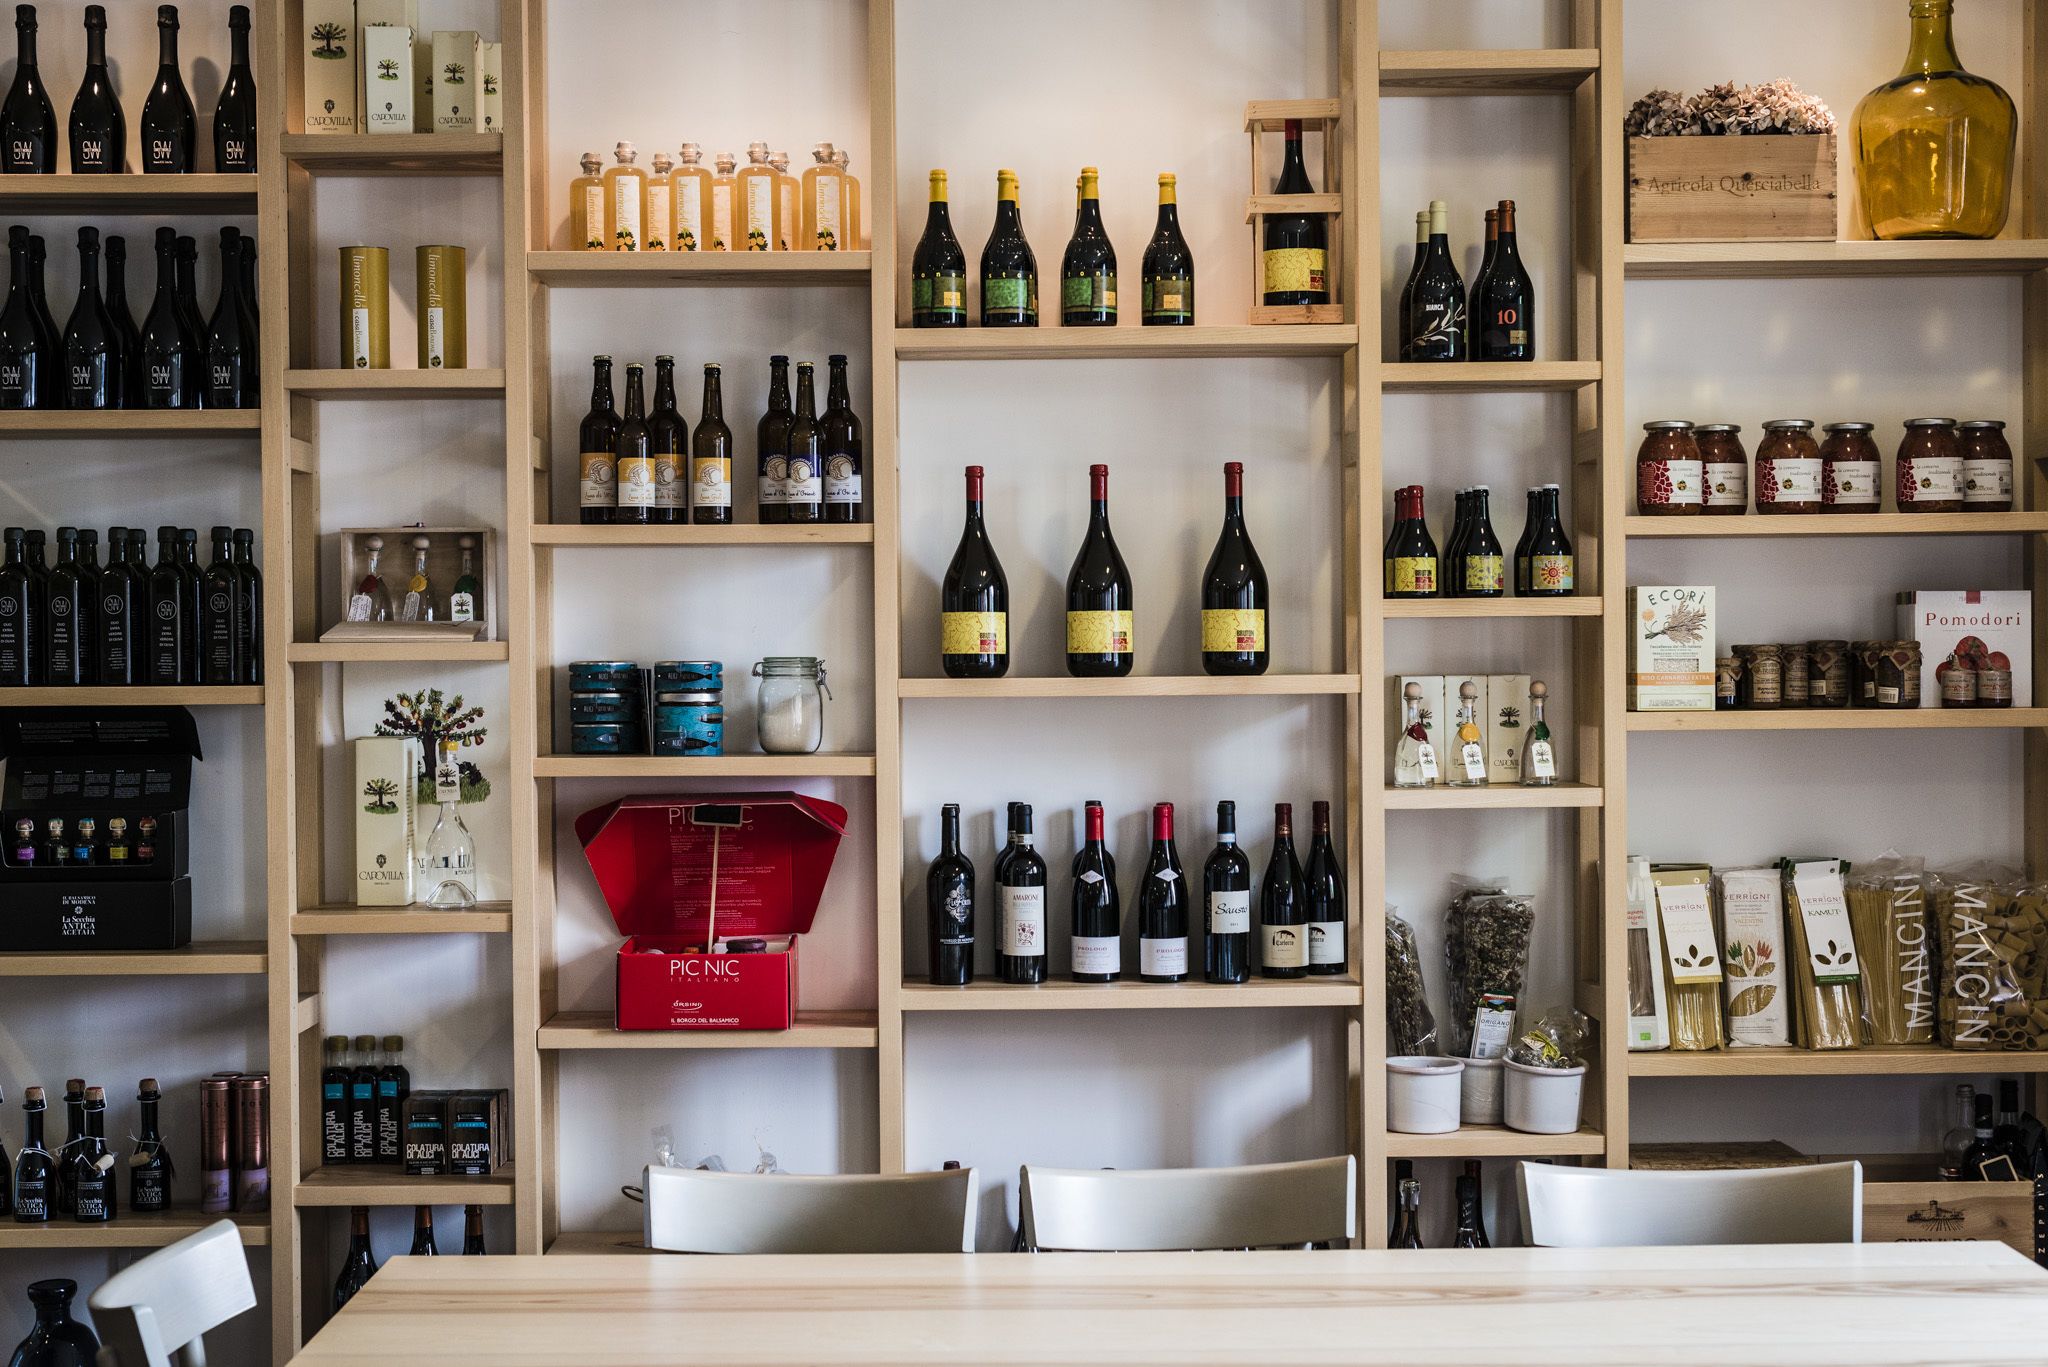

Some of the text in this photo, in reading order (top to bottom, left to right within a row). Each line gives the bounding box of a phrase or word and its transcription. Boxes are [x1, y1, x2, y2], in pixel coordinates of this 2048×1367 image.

[307, 116, 353, 126] CAPOVILLA
[371, 113, 407, 121] CAPOVILLA
[1648, 174, 1820, 198] Agricola Querciabella
[353, 255, 367, 308] limoncello
[428, 254, 441, 307] limoncello
[1497, 308, 1517, 325] 10
[1925, 612, 2021, 626] Pomodori
[359, 870, 404, 881] CAPOVILLA
[1723, 893, 1770, 901] VERRIGNI
[1801, 896, 1842, 904] VERRIGNI
[1663, 903, 1705, 911] VERRIGNI
[1893, 874, 1934, 1029] MANCINI
[670, 959, 740, 976] PIC NIC
[1953, 883, 1990, 1044] MANCIN
[1480, 1018, 1510, 1027] ORIGANO
[326, 1110, 336, 1158] COLATURA
[353, 1109, 364, 1158] COLATURA
[380, 1107, 390, 1155] COLATURA
[406, 1143, 445, 1152] COLATURA
[451, 1143, 490, 1152] COLATURA
[406, 1151, 435, 1159] DI ALICI
[451, 1151, 480, 1159] DI ALICI
